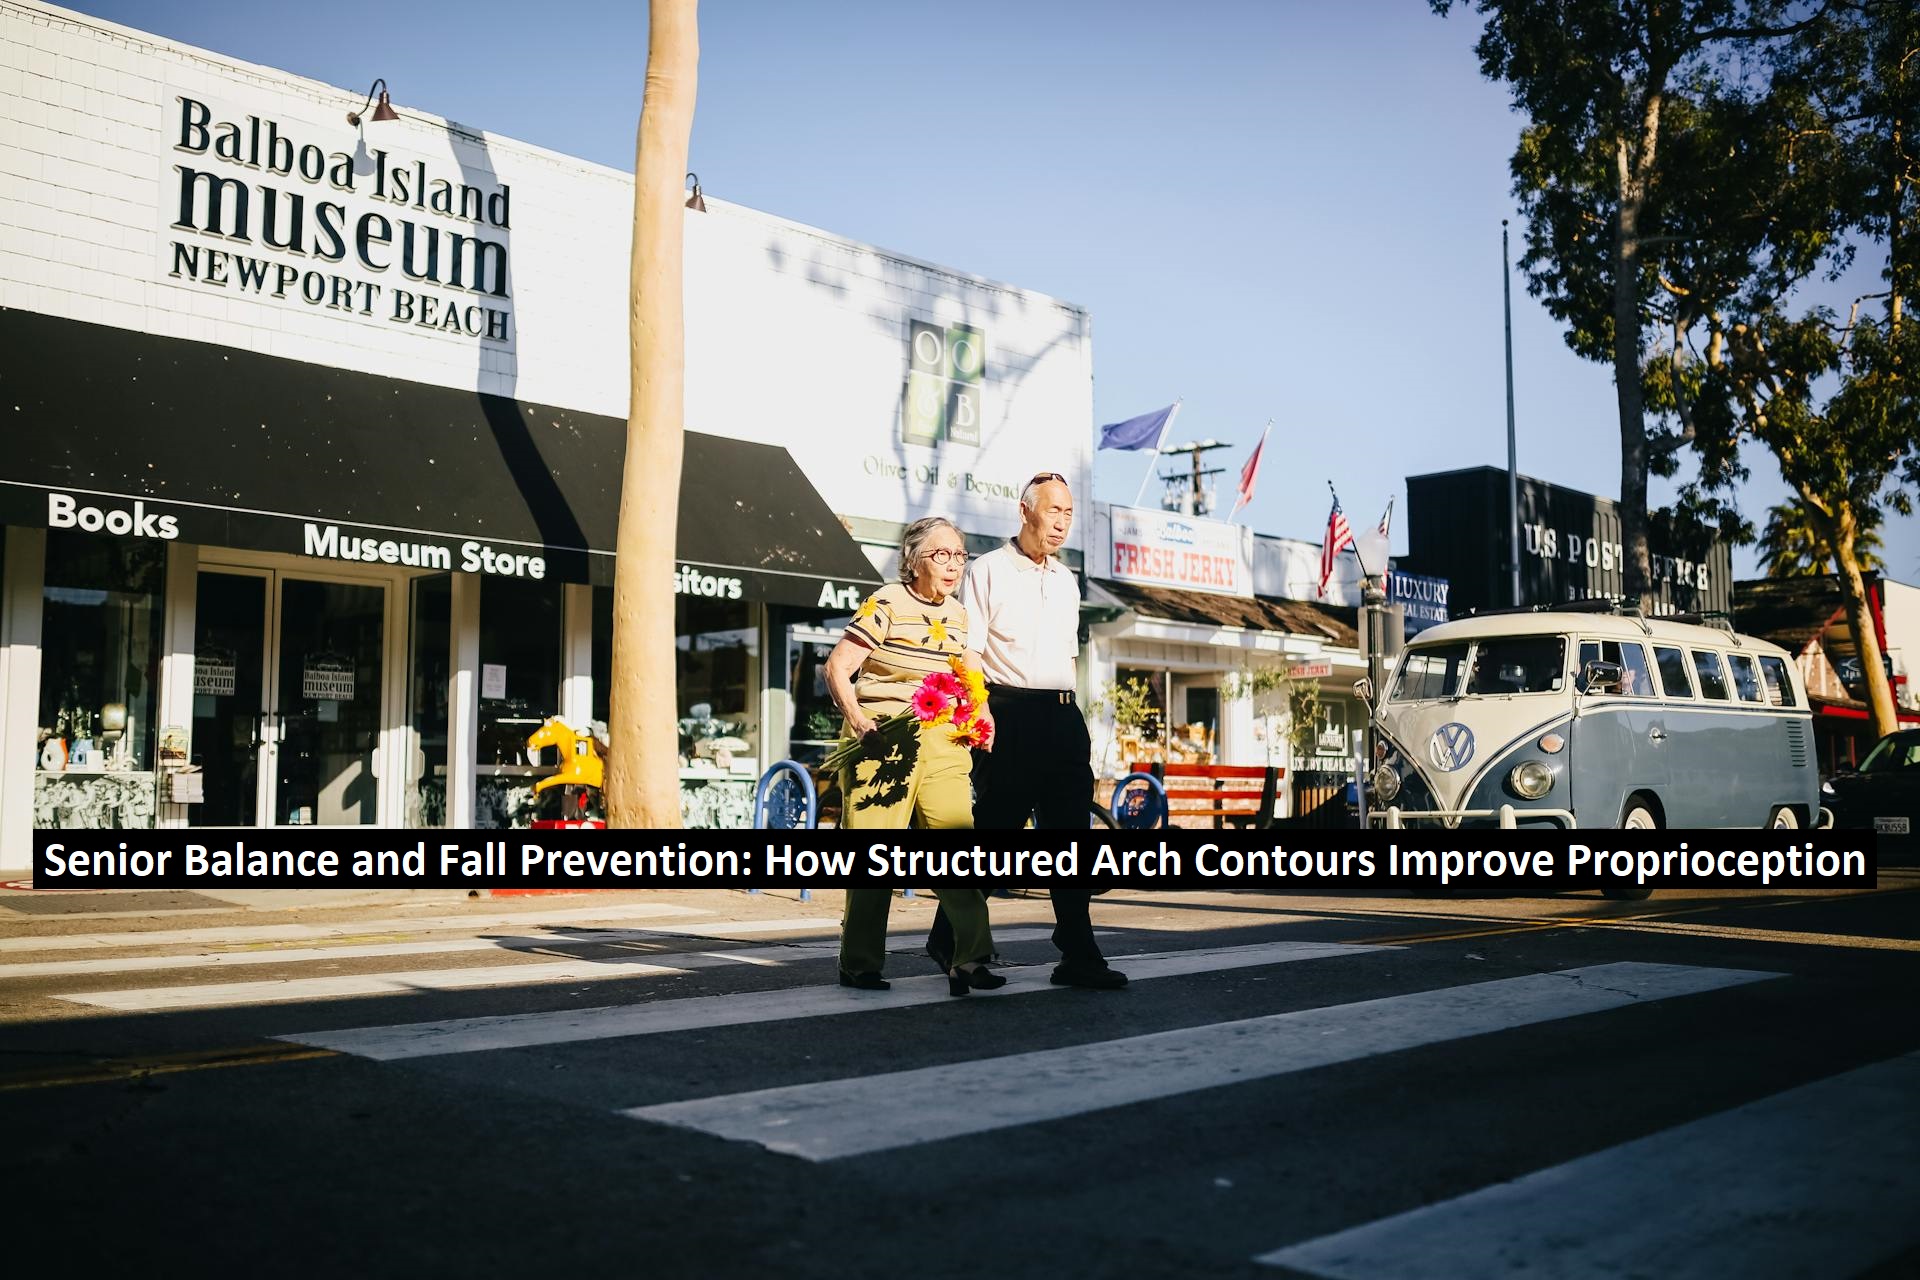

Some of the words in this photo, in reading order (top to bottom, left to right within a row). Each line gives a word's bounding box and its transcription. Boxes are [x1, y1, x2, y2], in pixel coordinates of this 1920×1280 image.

[174, 95, 356, 192] Balboa
[370, 148, 511, 232] Island
[170, 164, 511, 299] museum
[168, 241, 381, 316] NEWPORT
[389, 288, 510, 342] BEACH
[915, 331, 942, 365] O
[952, 340, 977, 373] O
[956, 393, 975, 427] B
[864, 456, 907, 479] Olive
[916, 464, 939, 486] Oil
[965, 472, 1020, 501] Beyond
[48, 493, 180, 539] Books
[304, 522, 451, 570] Museum
[461, 541, 547, 580] Store
[1114, 542, 1176, 580] FRESH
[1180, 552, 1236, 587] JERKY
[674, 565, 743, 600] sitors
[1395, 575, 1449, 605] LUXURY
[1652, 552, 1709, 591] FFICE
[818, 581, 862, 611] Art
[210, 666, 235, 677] Island
[304, 671, 330, 681] Balboa
[331, 672, 354, 682] Island
[304, 680, 354, 693] museum
[1293, 756, 1322, 771] UXURY
